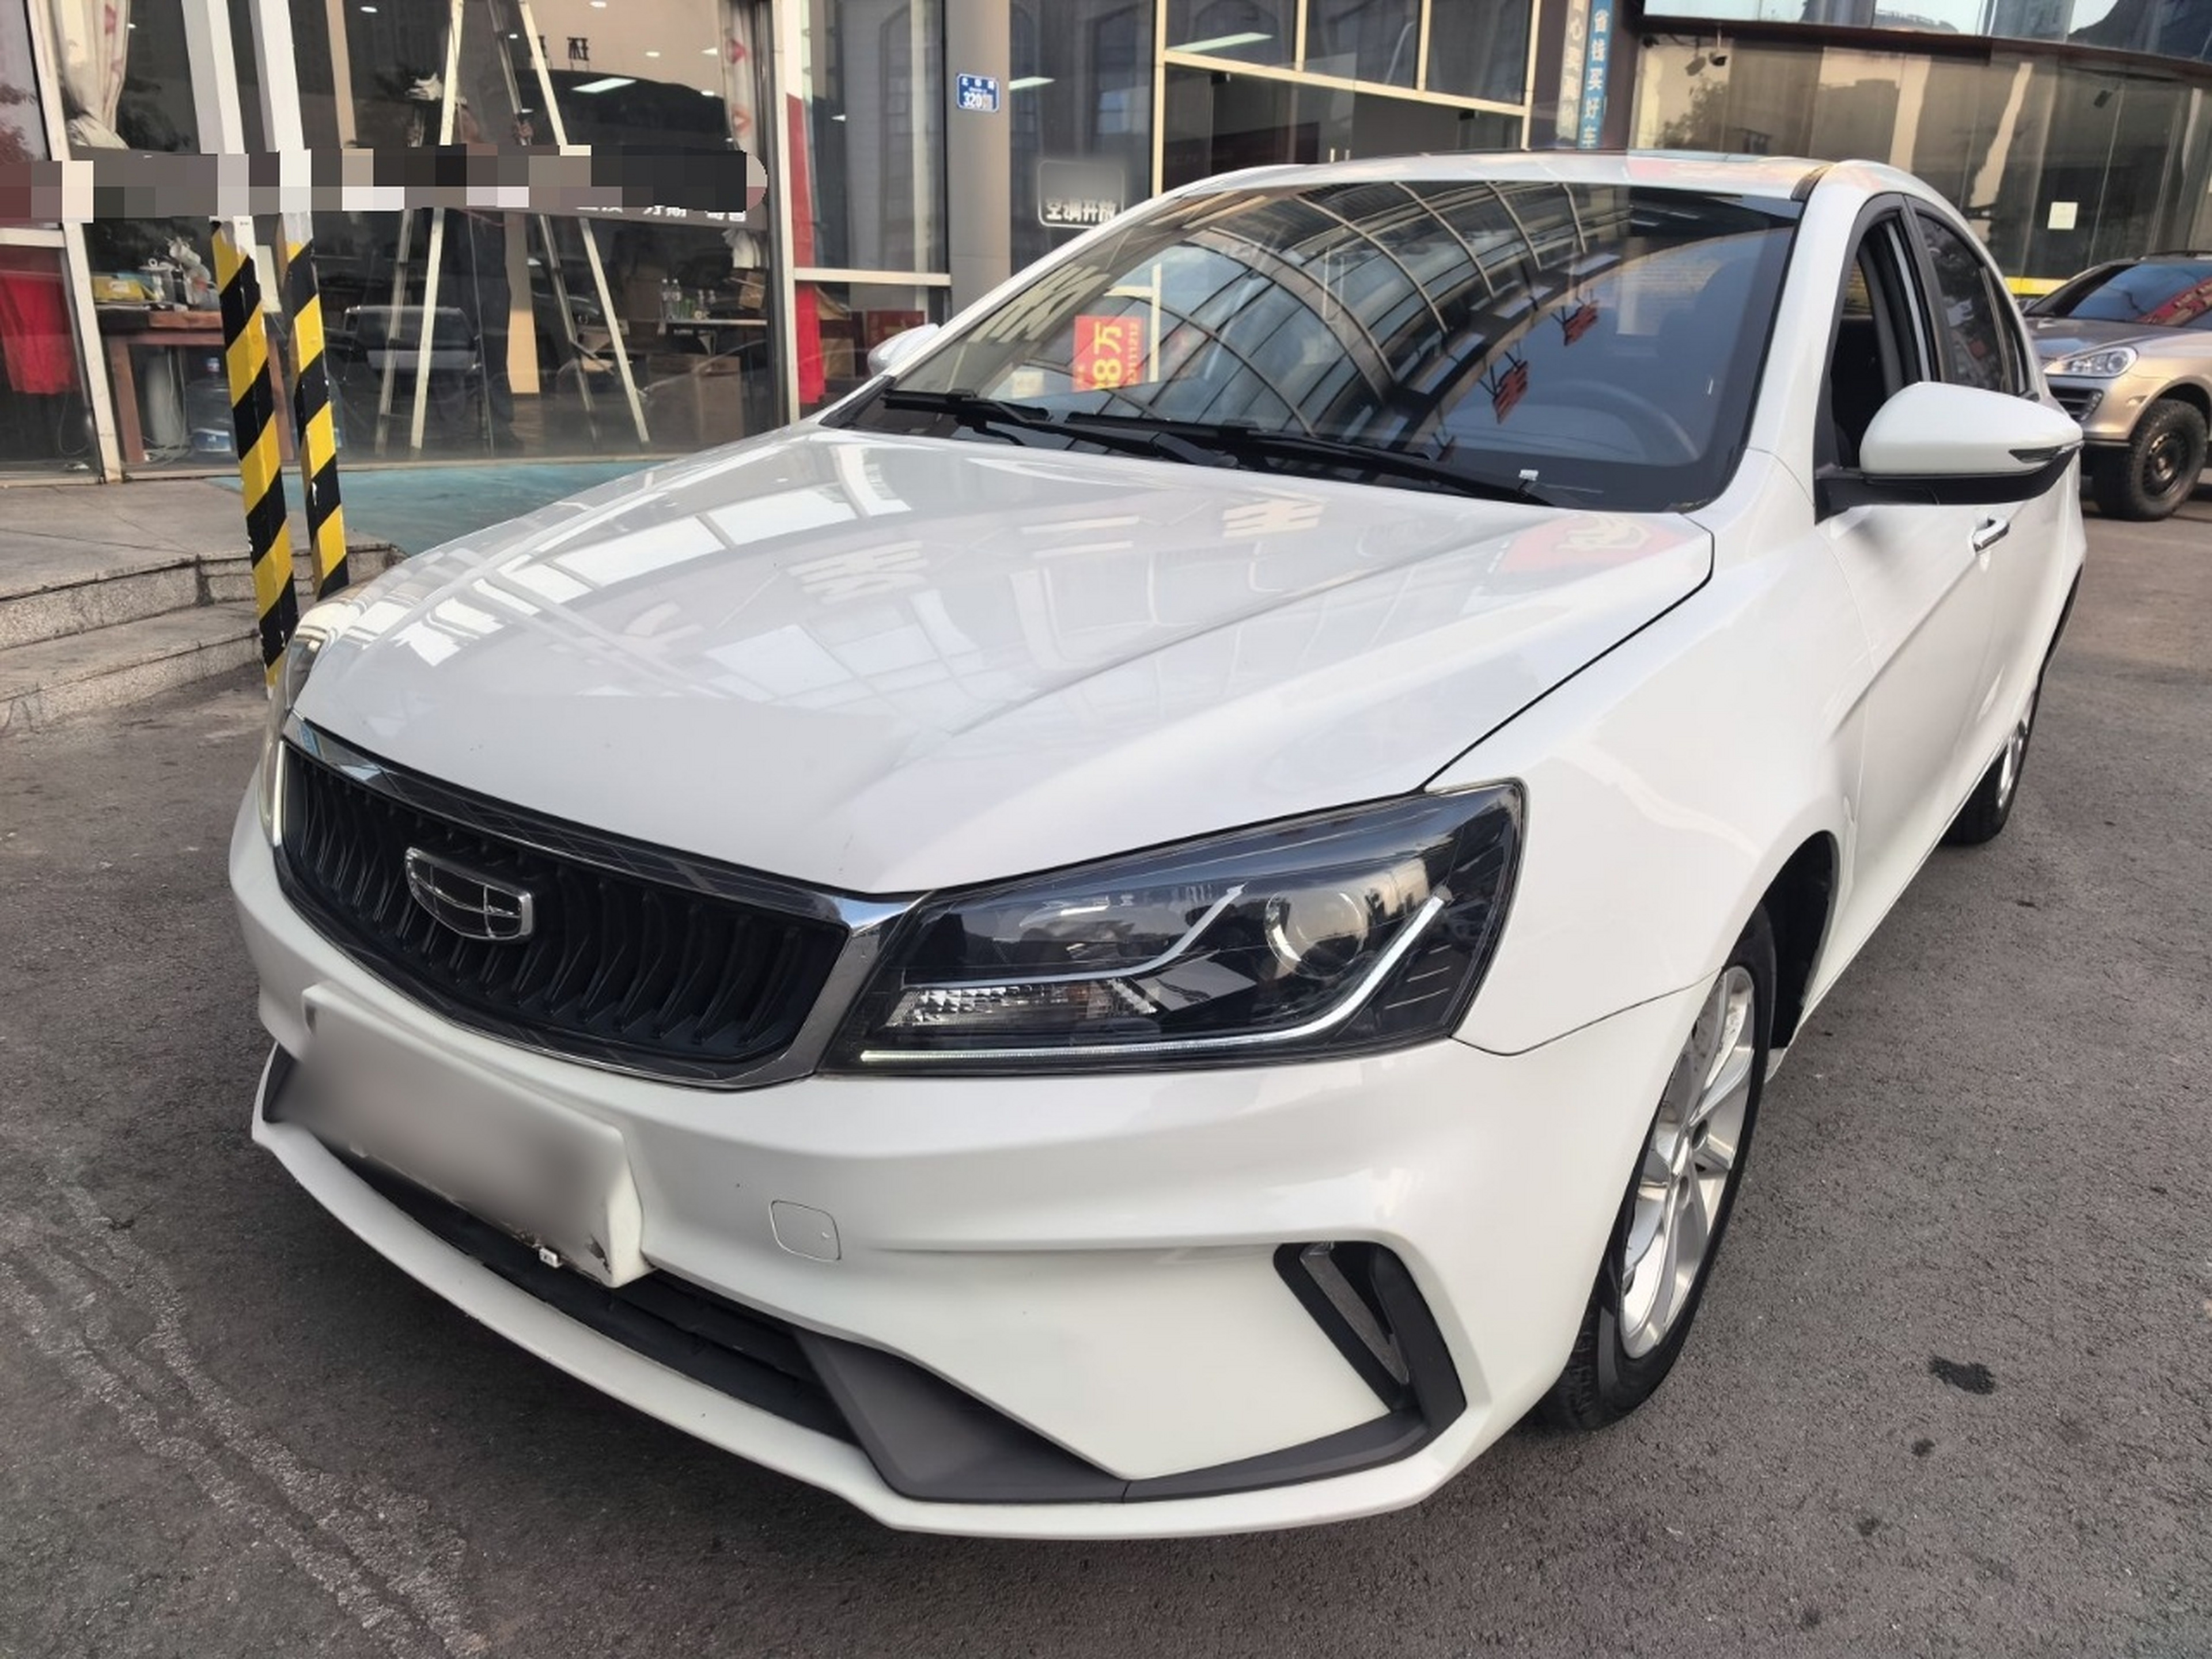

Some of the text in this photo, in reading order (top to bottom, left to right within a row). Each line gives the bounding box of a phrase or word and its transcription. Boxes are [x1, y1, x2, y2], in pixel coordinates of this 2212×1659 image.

[1582, 9, 1609, 149] 省钱买好车
[1092, 320, 1122, 389] 8万
